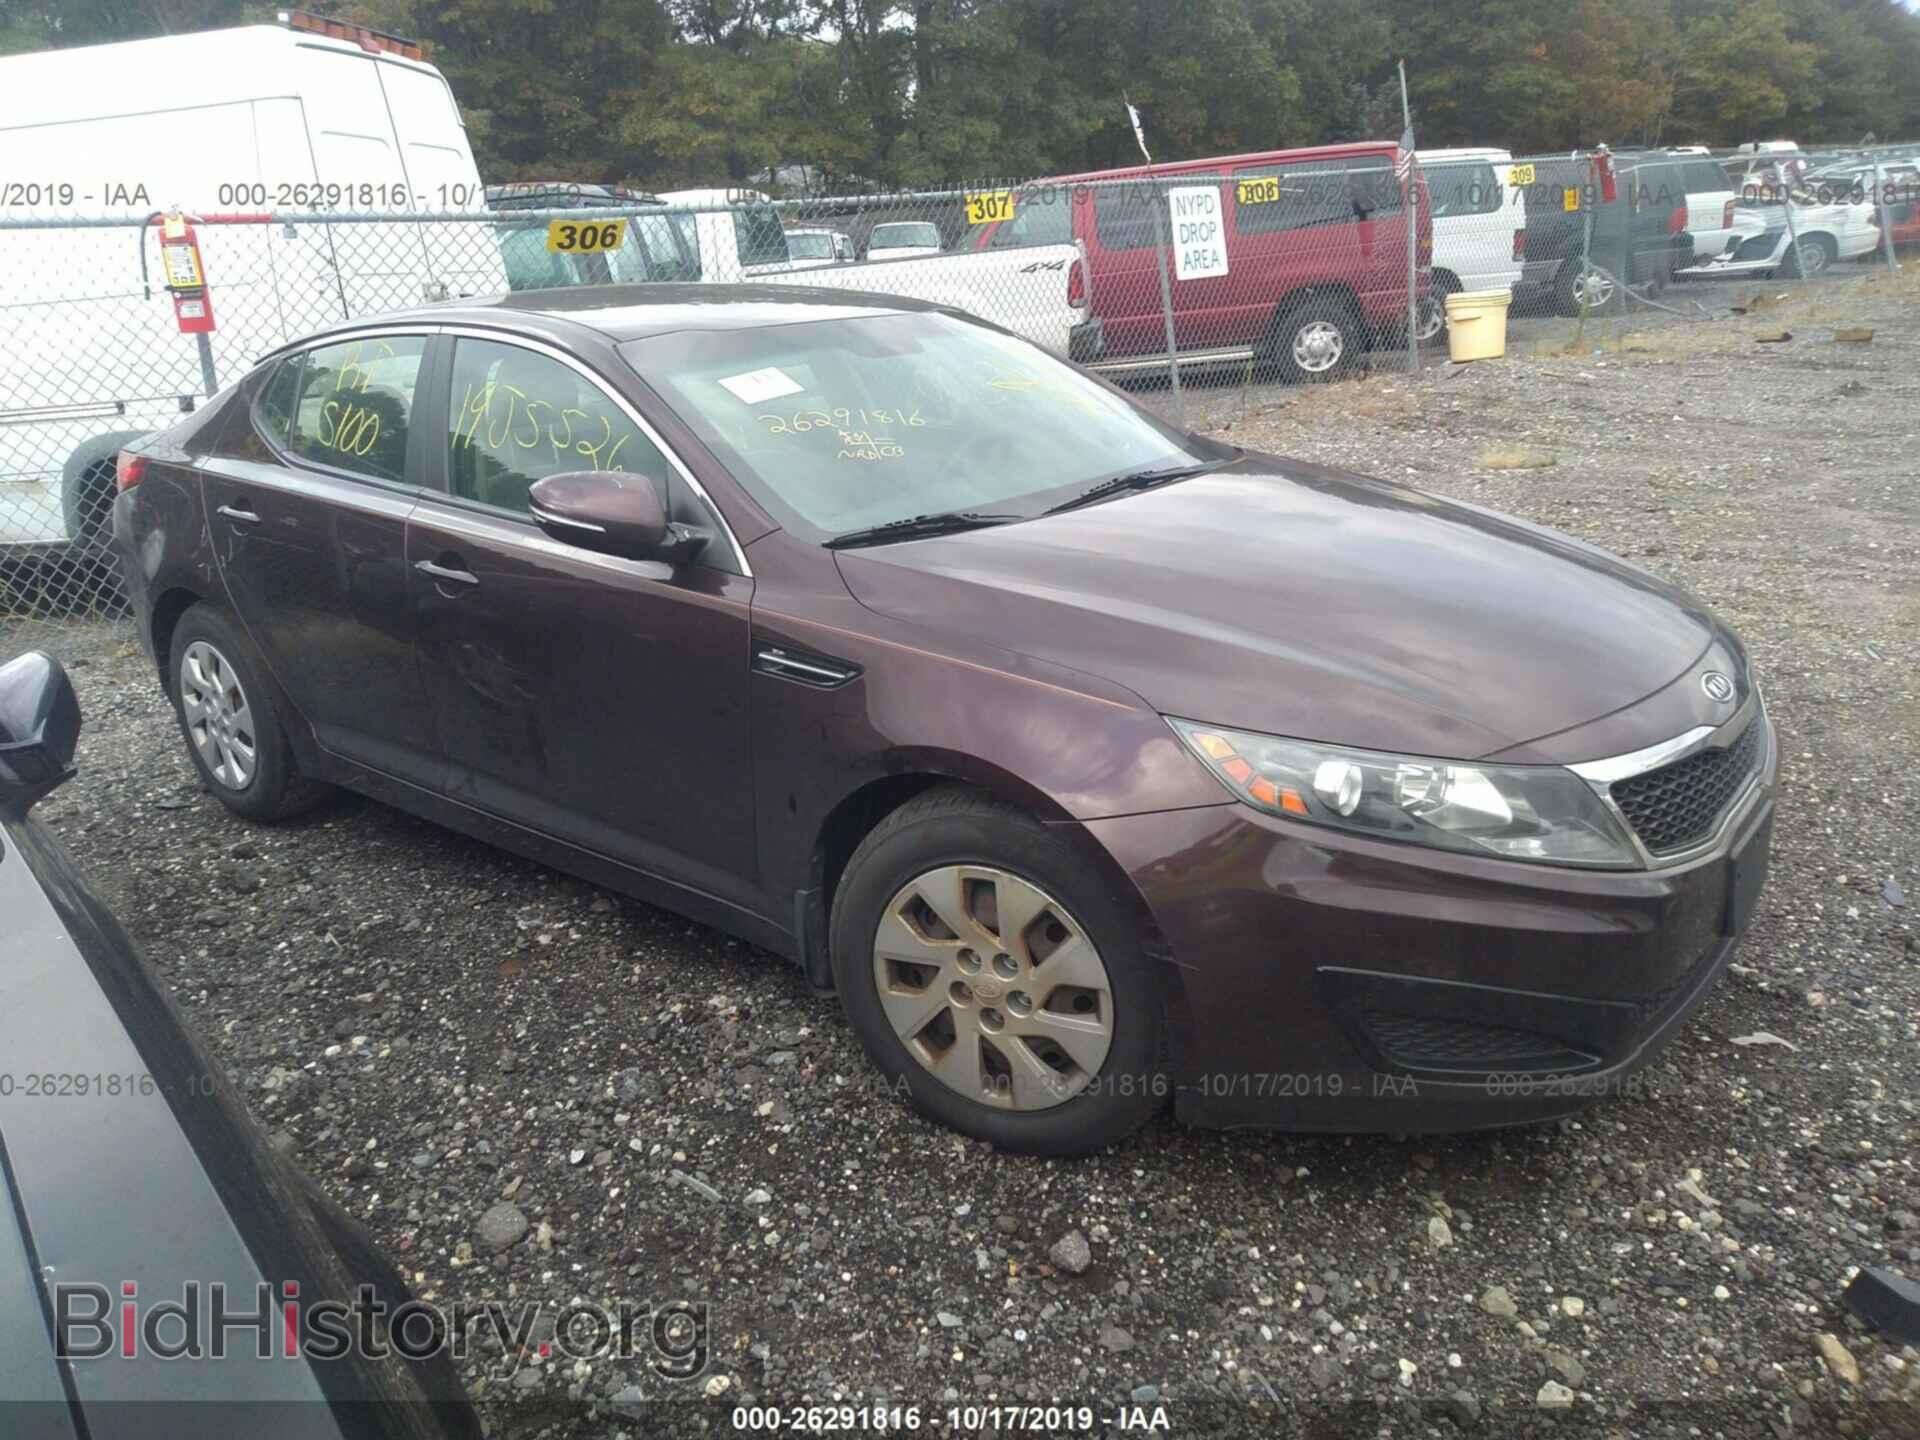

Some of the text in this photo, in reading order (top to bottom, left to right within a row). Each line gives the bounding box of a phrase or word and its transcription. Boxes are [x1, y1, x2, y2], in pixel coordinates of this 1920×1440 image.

[974, 195, 1010, 220] 307
[1175, 194, 1216, 217] NYPD
[556, 223, 619, 250] 306
[1179, 224, 1218, 244] DROP
[1183, 252, 1222, 272] AREA
[757, 408, 926, 434] 26291816
